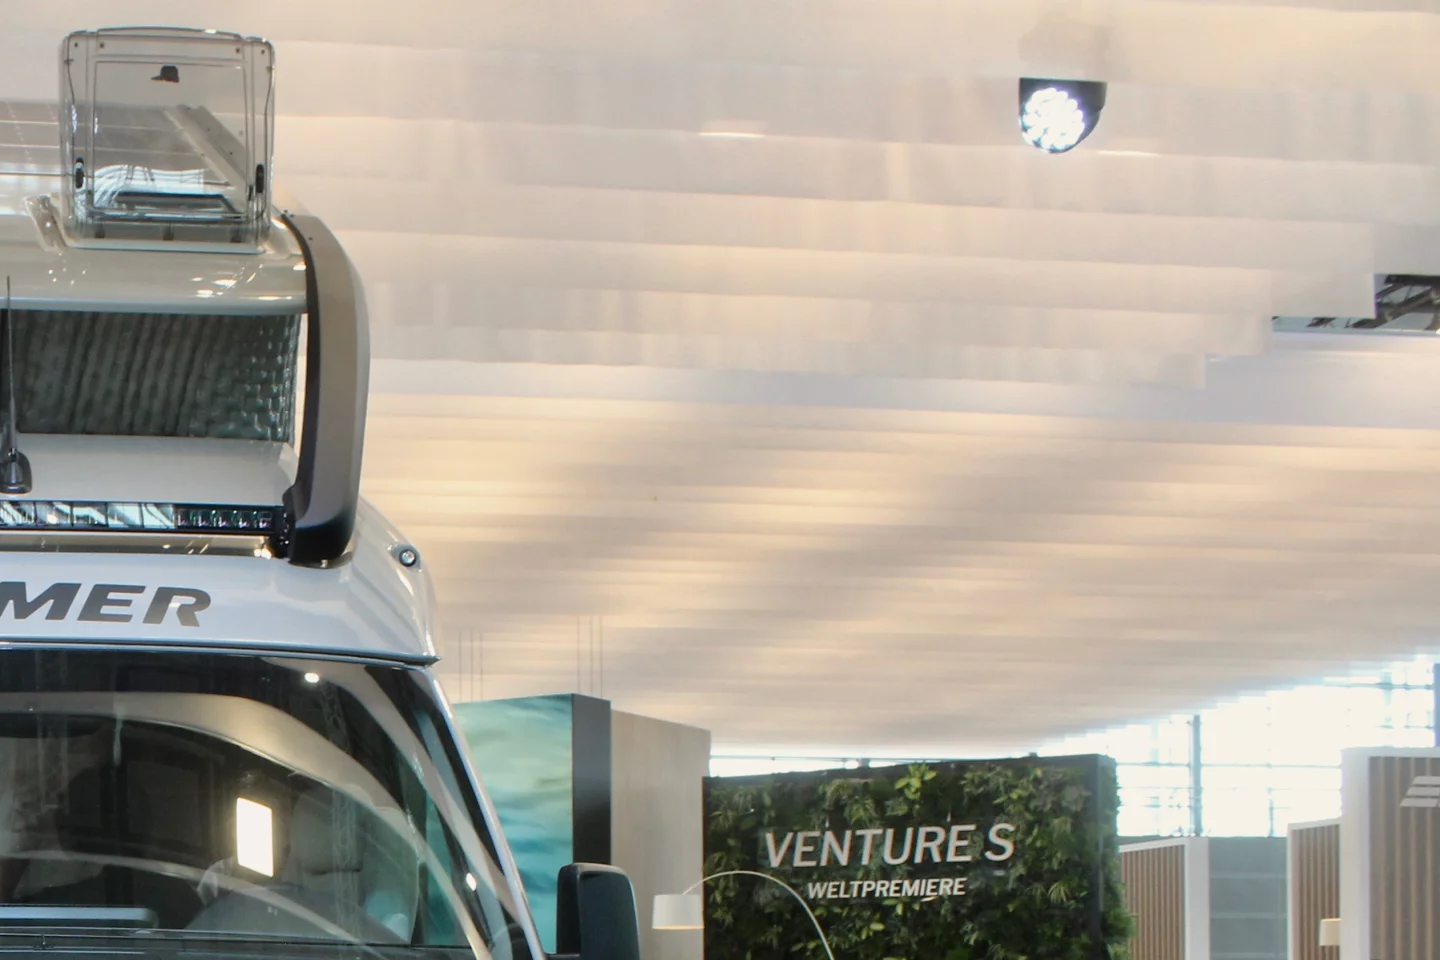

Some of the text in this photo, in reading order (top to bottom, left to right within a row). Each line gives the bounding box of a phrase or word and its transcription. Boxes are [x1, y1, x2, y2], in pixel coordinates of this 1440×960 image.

[765, 822, 1016, 868] VENTURE S
[808, 877, 968, 899] WELTPREMIERE
